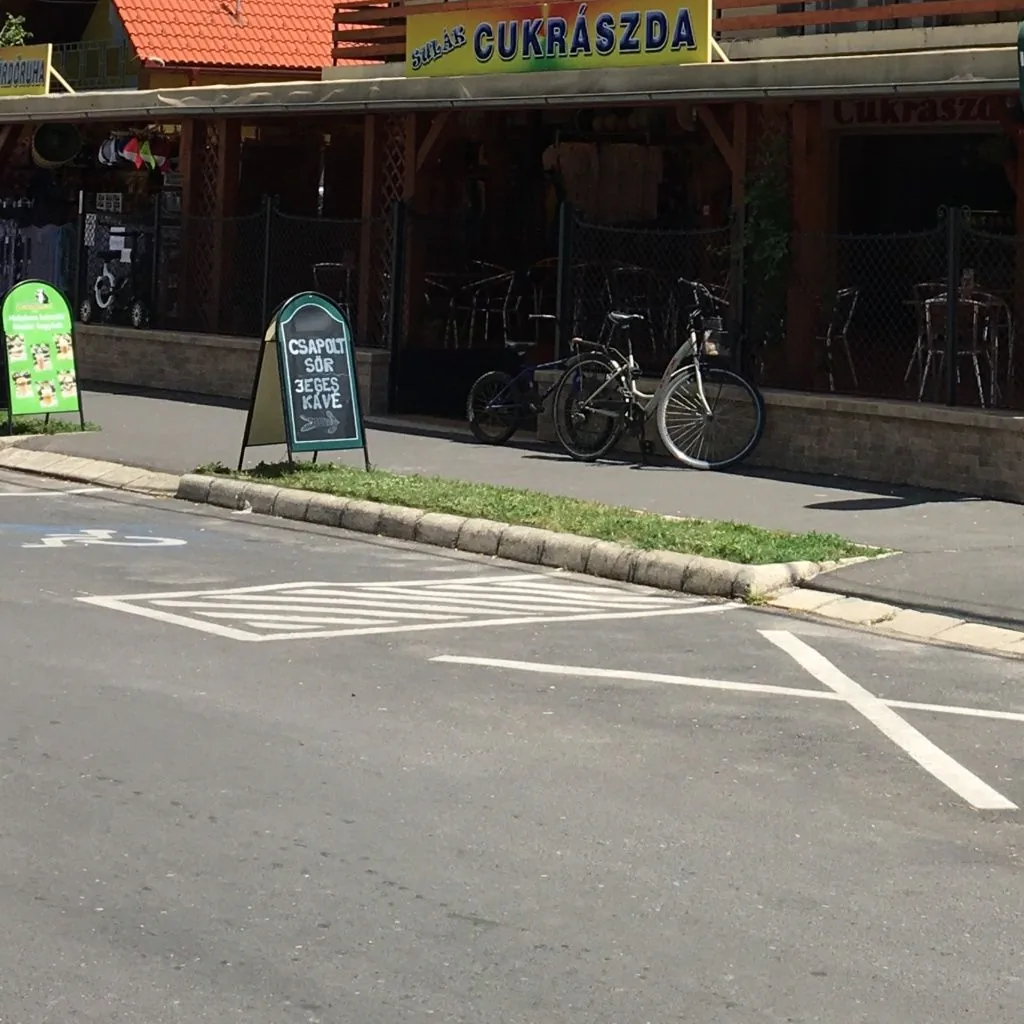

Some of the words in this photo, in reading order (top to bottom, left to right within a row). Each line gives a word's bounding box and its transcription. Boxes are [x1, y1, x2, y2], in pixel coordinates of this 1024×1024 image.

[473, 3, 698, 63] CUKRÁSZDA
[288, 337, 345, 355] CSAPOLT
[304, 355, 334, 373] SÖR
[302, 390, 343, 410] KÁVÉ
